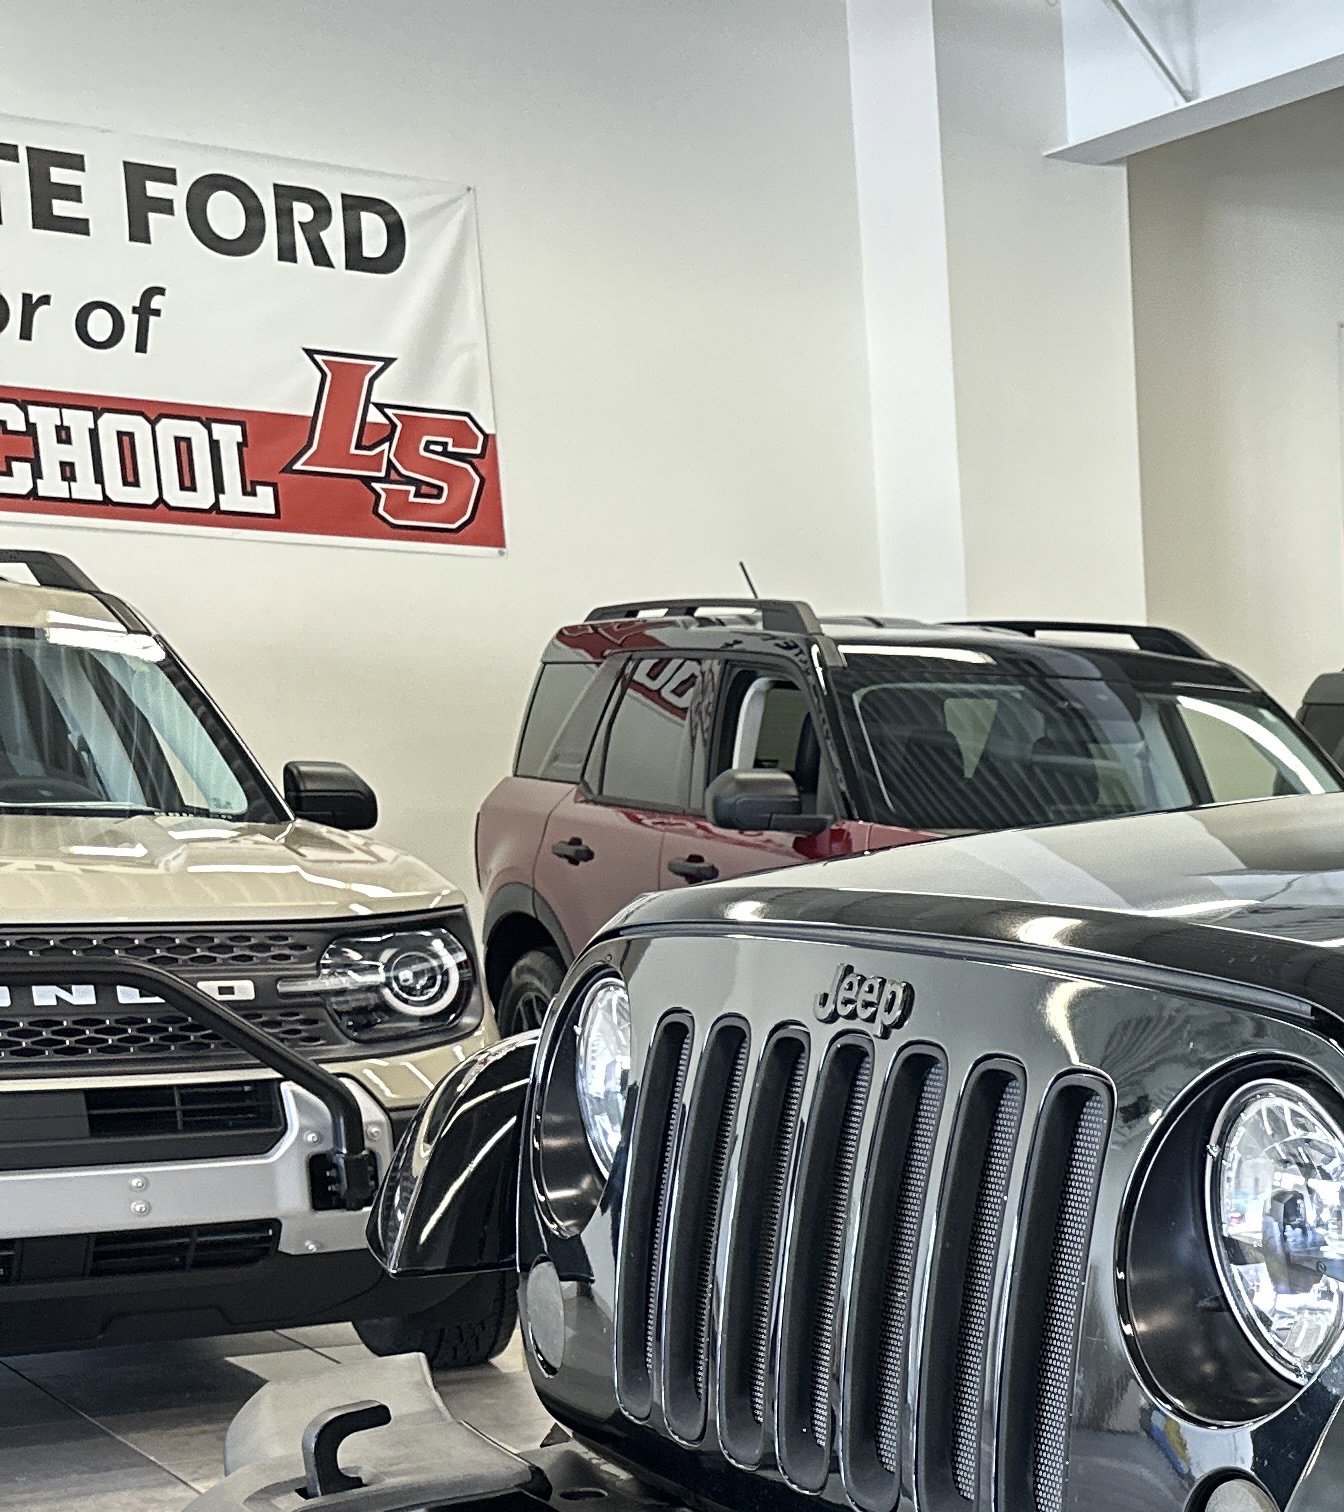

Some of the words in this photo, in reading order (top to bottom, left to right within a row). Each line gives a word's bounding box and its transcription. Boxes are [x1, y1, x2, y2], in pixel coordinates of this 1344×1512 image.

[122, 160, 407, 275] FORD
[0, 290, 51, 342] r
[75, 286, 167, 354] of
[813, 962, 915, 1040] Jeep
